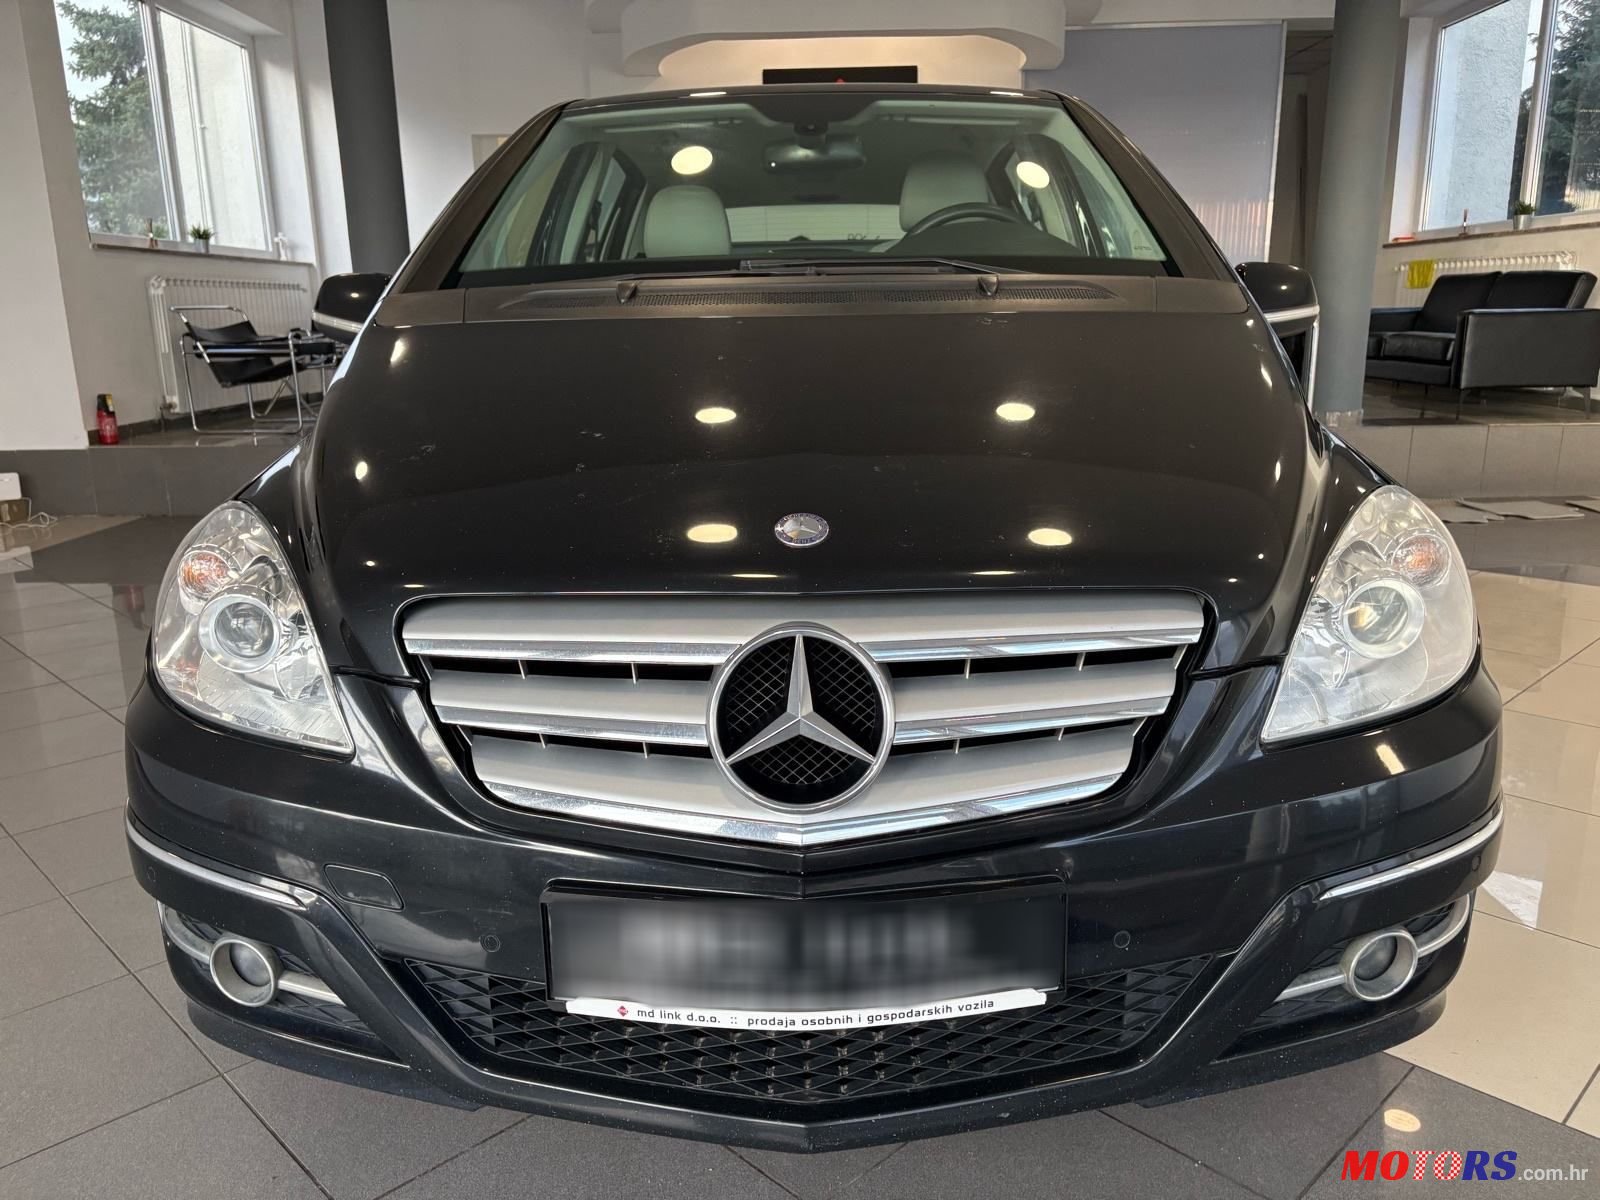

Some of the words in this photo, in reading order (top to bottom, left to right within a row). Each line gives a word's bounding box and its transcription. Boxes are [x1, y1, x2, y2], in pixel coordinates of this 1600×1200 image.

[637, 1007, 655, 1019] md
[660, 1010, 681, 1021] link
[687, 1012, 721, 1024] d.o.o.
[747, 1016, 796, 1029] prodaja
[801, 1015, 853, 1026] osobnih
[867, 1005, 953, 1024] gospodarskih
[958, 1000, 994, 1012] vozila
